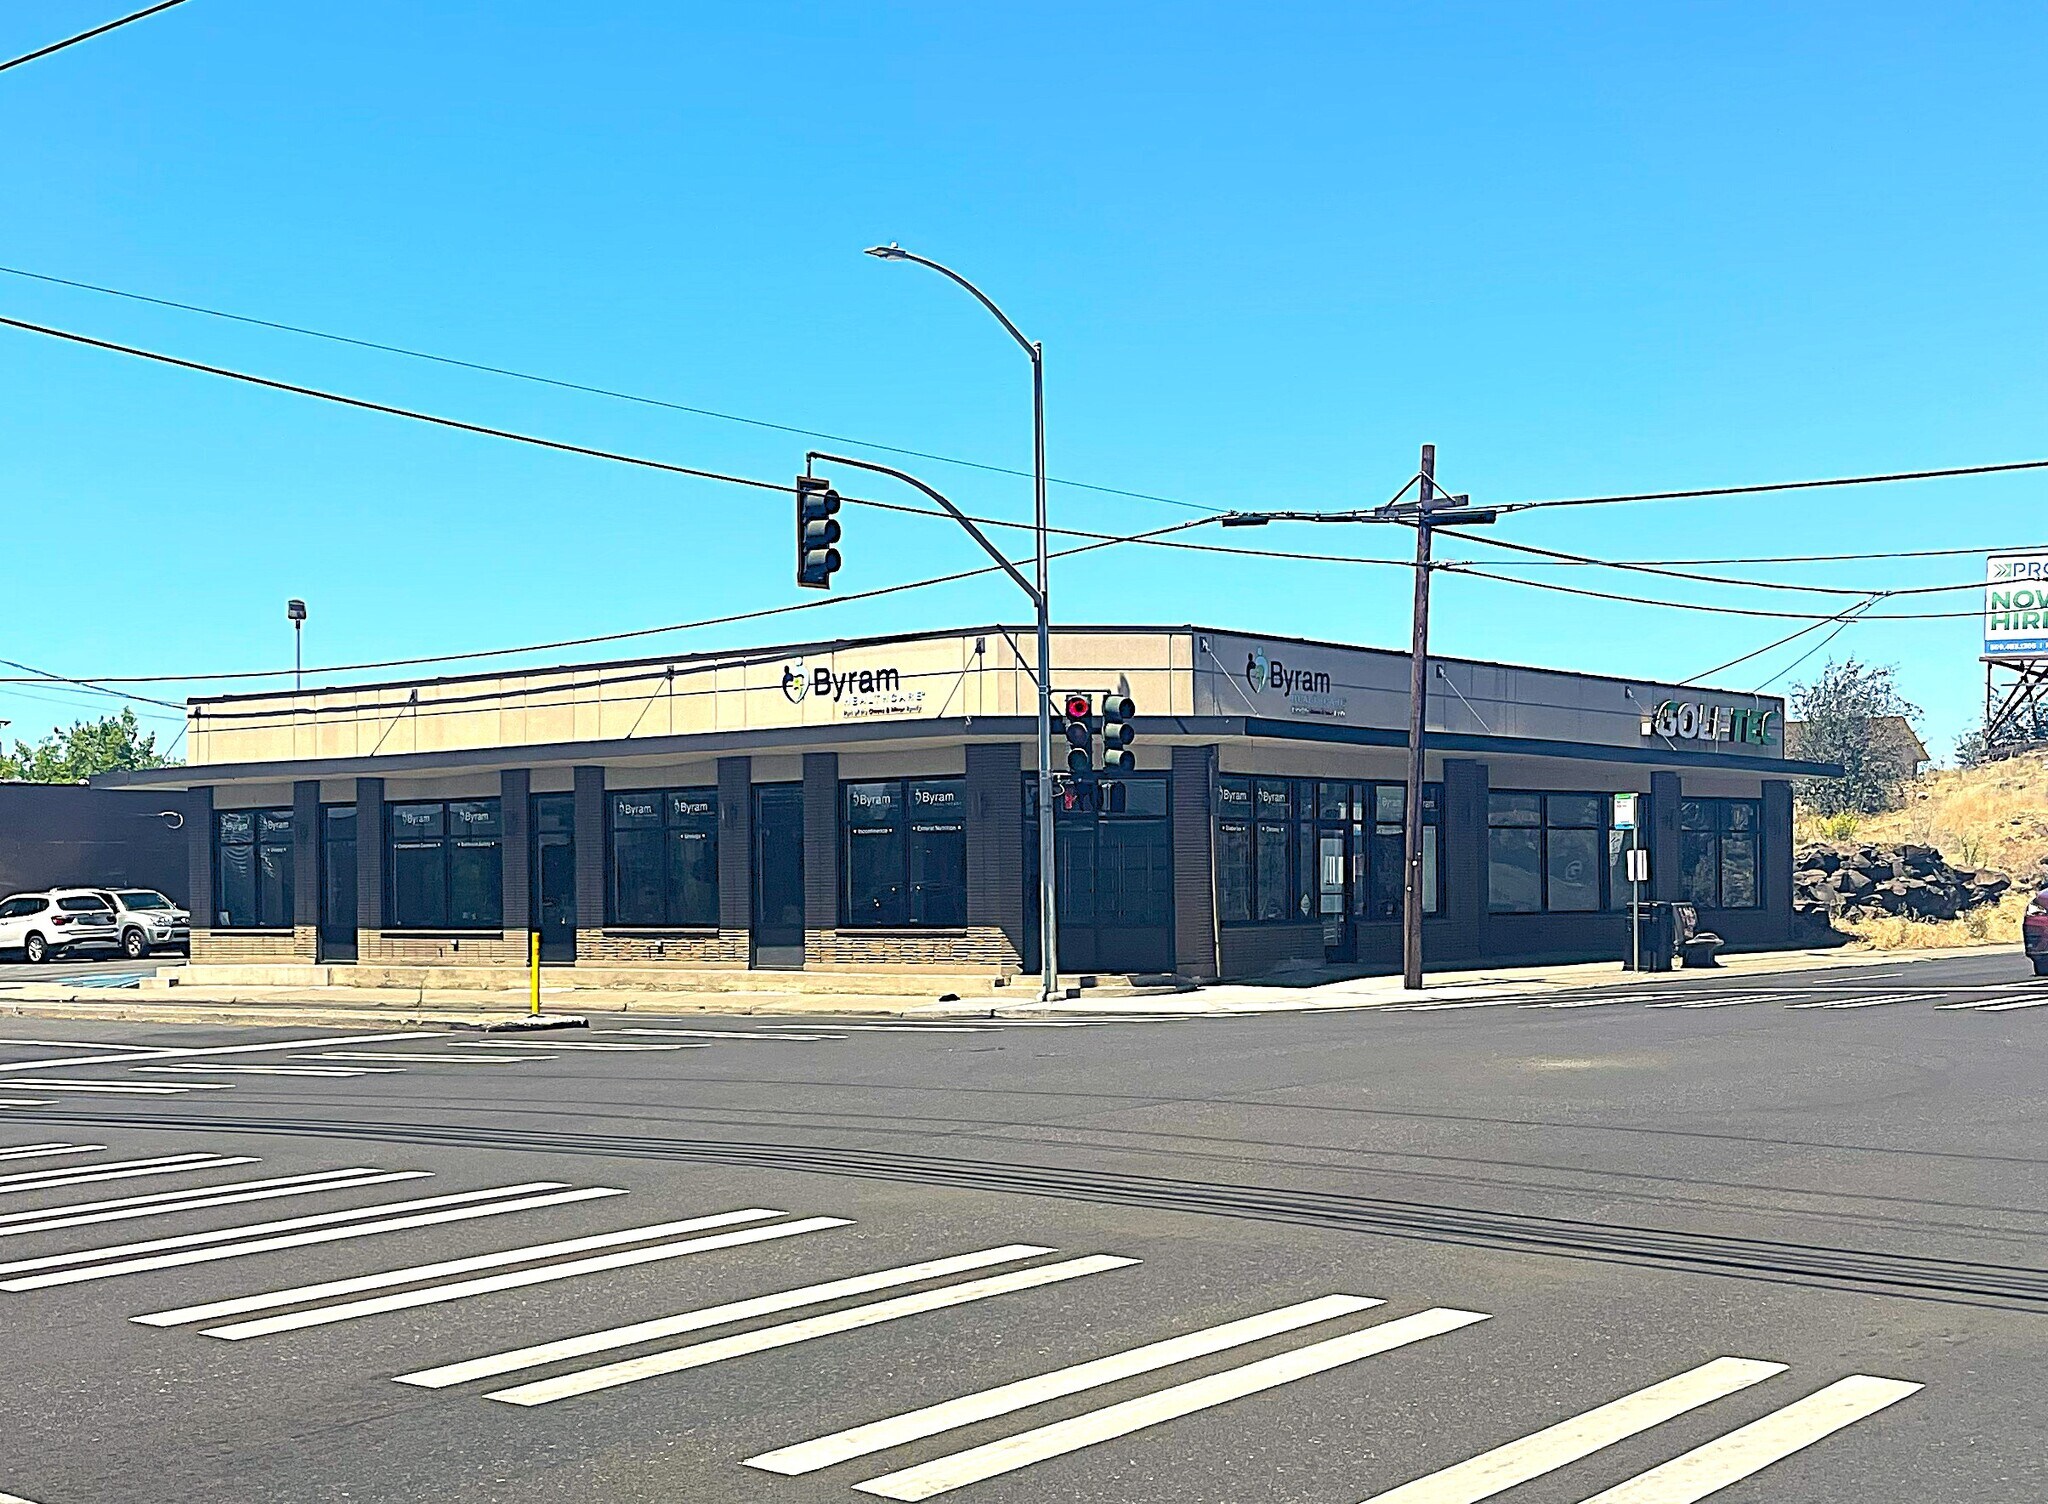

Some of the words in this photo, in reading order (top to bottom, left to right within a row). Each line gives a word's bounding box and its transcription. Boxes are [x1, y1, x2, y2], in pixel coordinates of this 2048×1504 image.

[2014, 562, 2048, 577] PR
[814, 667, 899, 702] Byram
[1270, 660, 1331, 697] Byram
[860, 795, 891, 807] Byram
[922, 791, 954, 805] Byram
[1223, 788, 1247, 803] Byram
[1263, 790, 1286, 804] Byram
[625, 804, 652, 816] Byram
[680, 801, 708, 815] Byram
[407, 813, 431, 824] Byram
[464, 811, 489, 823] Byram
